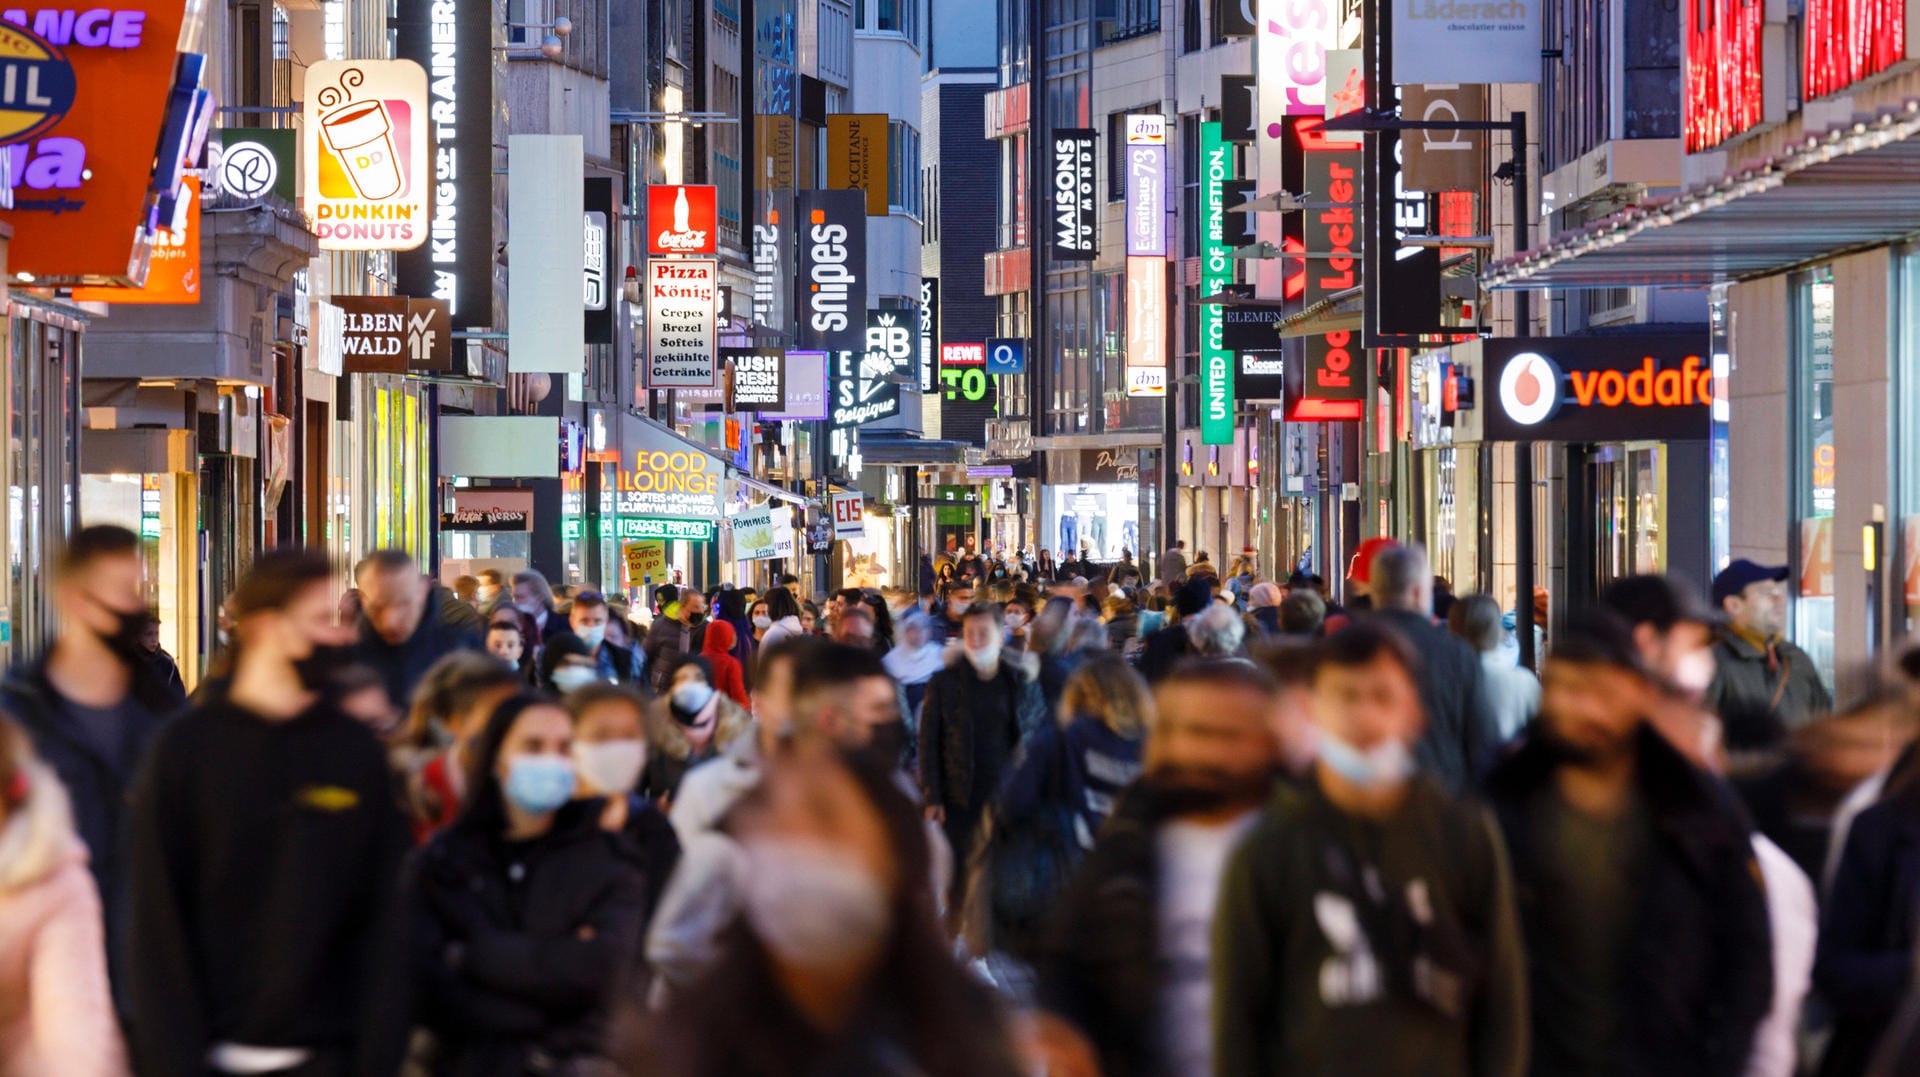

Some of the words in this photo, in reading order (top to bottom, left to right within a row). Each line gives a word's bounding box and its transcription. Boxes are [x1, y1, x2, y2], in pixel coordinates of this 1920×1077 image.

[1448, 23, 1495, 31] chocolatier
[1135, 120, 1160, 135] dm
[1133, 149, 1157, 177] 73
[1081, 139, 1092, 211] MONDE
[1056, 139, 1076, 250] MAISONS
[317, 204, 418, 220] DUNKIN'
[432, 181, 456, 262] KING
[1320, 162, 1354, 289] Locker
[317, 223, 413, 240] DONUTS
[1081, 224, 1092, 250] DU
[1210, 247, 1226, 271] OF
[656, 265, 708, 279] Pizza
[811, 224, 855, 332] snipes
[653, 284, 712, 301] König
[661, 308, 703, 320] Crepes
[662, 323, 701, 333] Brezel
[342, 337, 402, 355] WALD
[660, 337, 703, 348] Softeis
[654, 352, 710, 364] gekühlte
[944, 346, 982, 361] REWE
[653, 367, 711, 377] Getränke
[1135, 372, 1160, 386] dm
[941, 368, 986, 400] TO
[1210, 357, 1226, 420] UNITED
[834, 399, 896, 425] Belgique
[637, 451, 706, 473] FOOD
[625, 471, 719, 494] LOUNGE
[836, 498, 862, 523] EIS
[733, 515, 771, 530] Pommes
[775, 540, 792, 550] urst
[629, 549, 661, 560] Coffee
[631, 562, 641, 570] to
[646, 560, 659, 570] go
